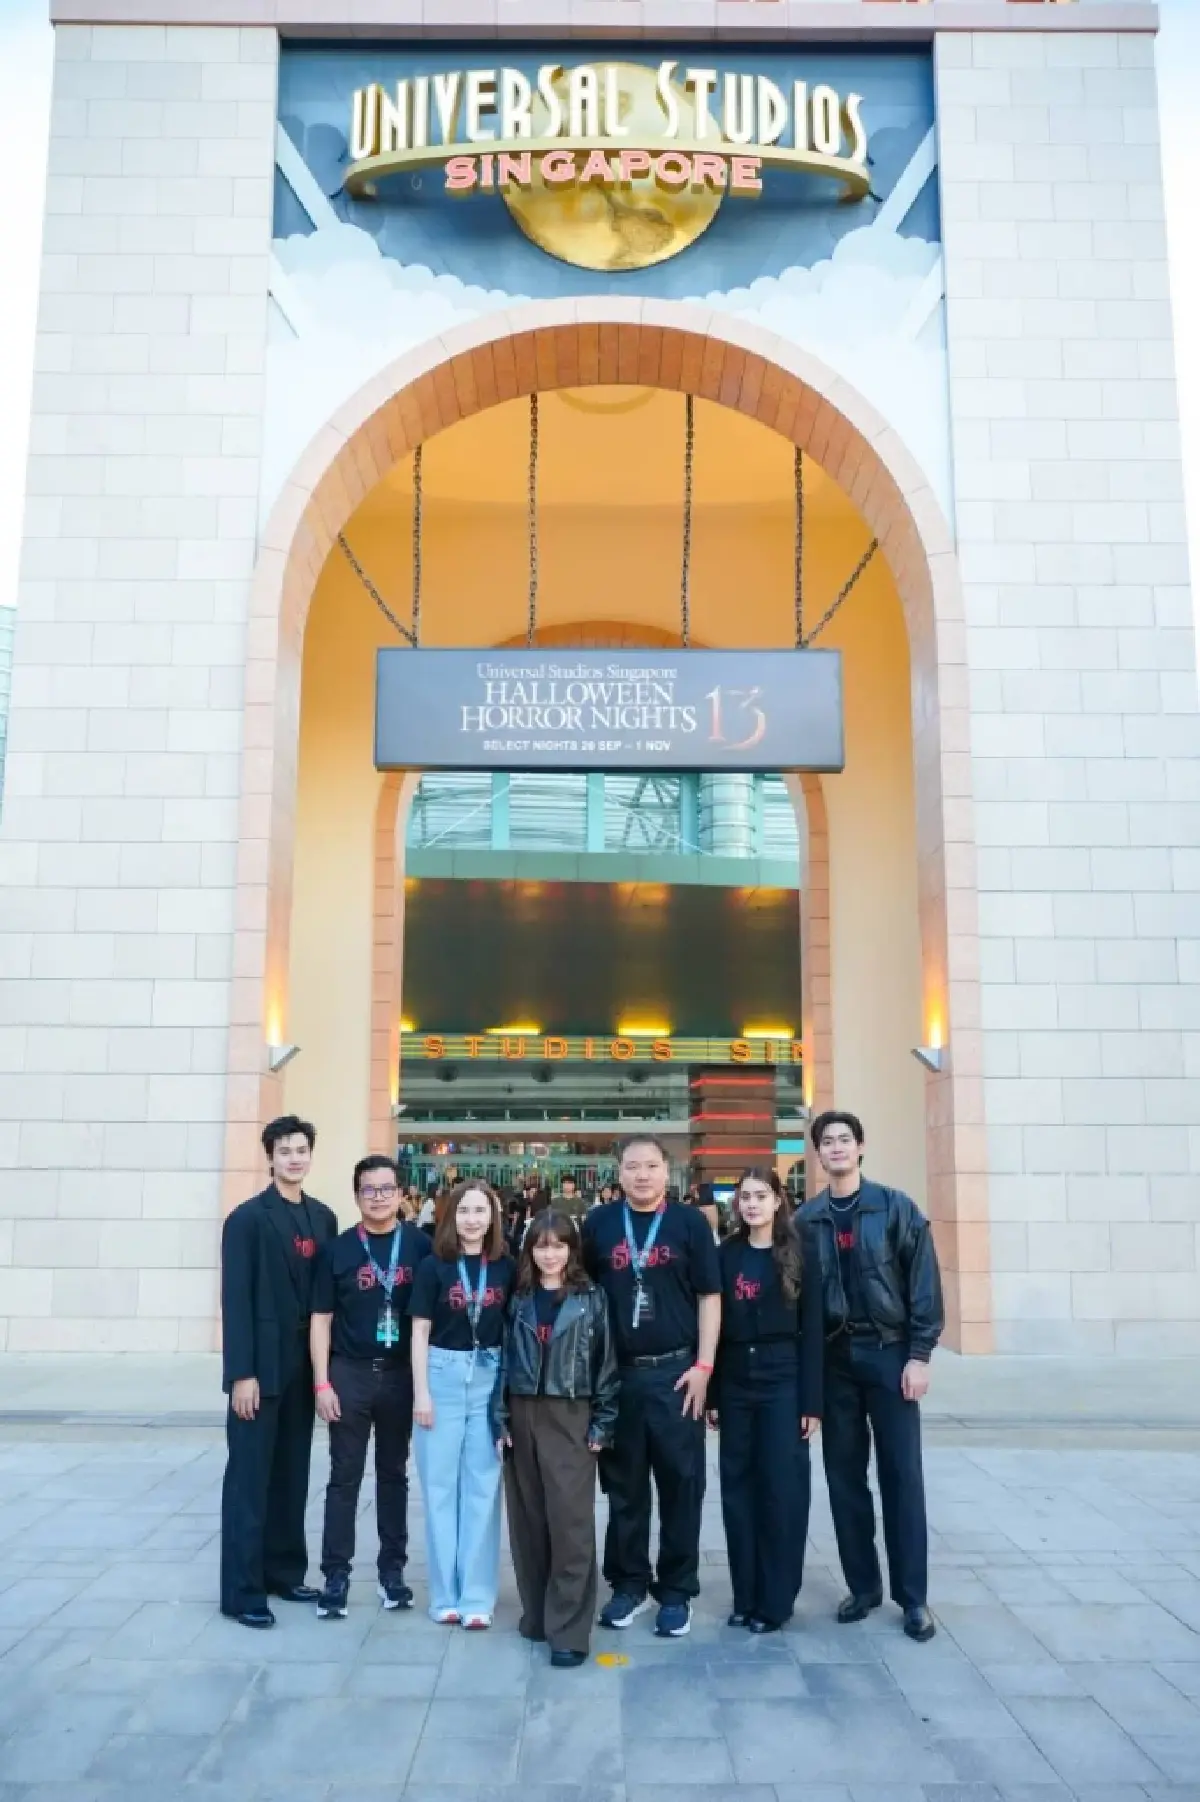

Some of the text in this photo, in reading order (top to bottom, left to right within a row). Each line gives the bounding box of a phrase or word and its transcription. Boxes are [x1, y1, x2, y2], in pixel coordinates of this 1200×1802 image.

[350, 60, 870, 163] UNIVERSAL STUDIOS
[444, 149, 763, 194] SINGAPORE
[477, 662, 678, 684] Universal Studios Singapore
[484, 681, 675, 705] HALLOWEEN
[459, 705, 698, 734] HORROR NIGHTS
[703, 684, 767, 750] 13
[483, 740, 530, 751] SELECT
[532, 740, 578, 751] NIGHTS
[598, 740, 622, 751] SEP
[645, 740, 671, 751] NOV
[423, 1034, 674, 1061] STUDIOS
